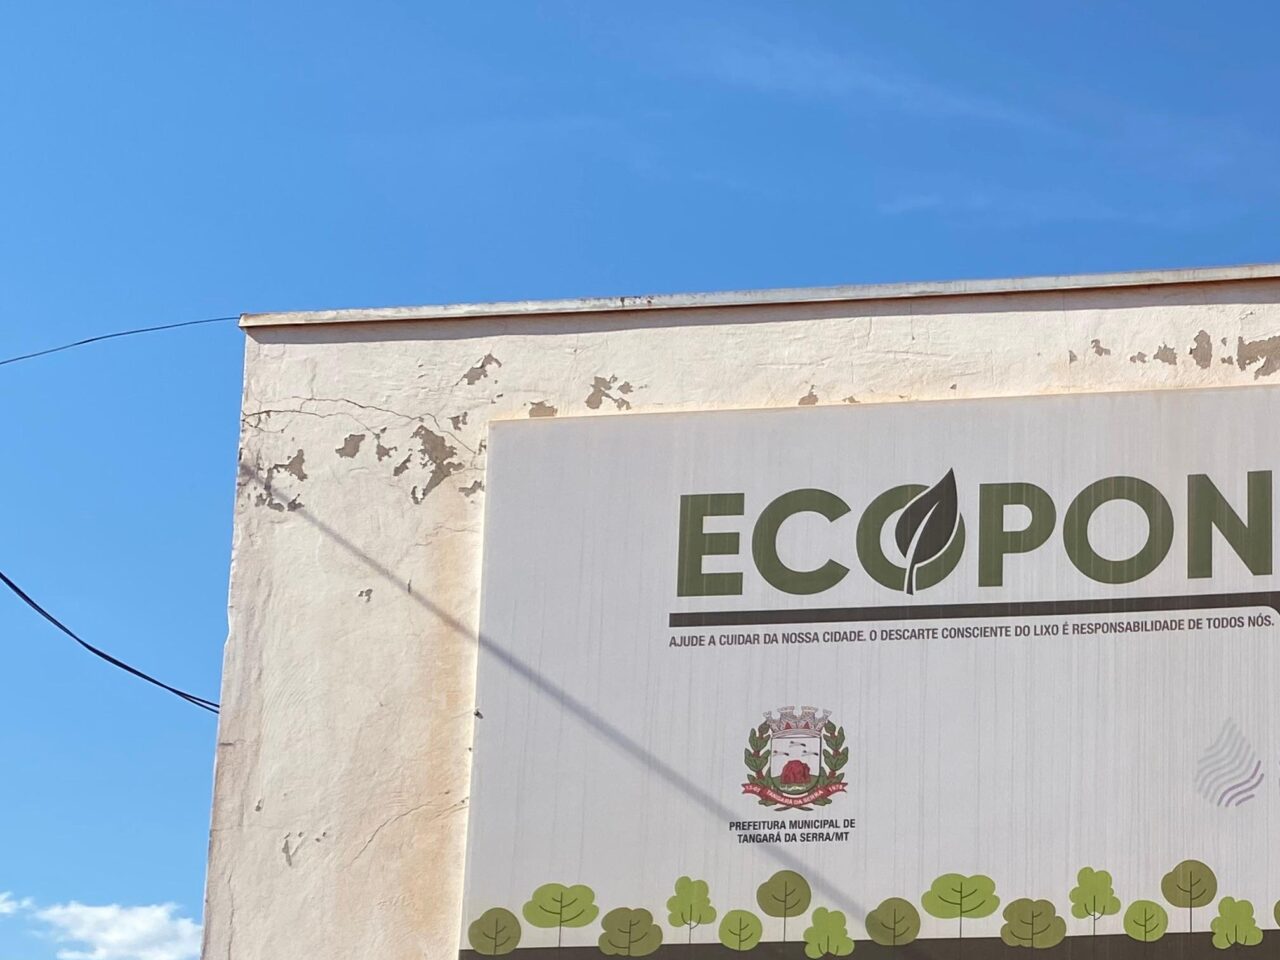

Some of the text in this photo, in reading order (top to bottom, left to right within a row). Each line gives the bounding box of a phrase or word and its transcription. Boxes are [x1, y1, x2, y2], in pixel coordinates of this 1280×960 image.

[669, 613, 1275, 647] AJUDE A CUIDAR DA NOSSA CIDADE. O DESCARTE CONSCIENTE DO LIXO É RESPONSABILIDADE DE TODOS NÓS.
[729, 818, 856, 831] PREFEITURA MUNICIPAL DE
[737, 831, 850, 844] TANGARÁ DA SERRA/MT
